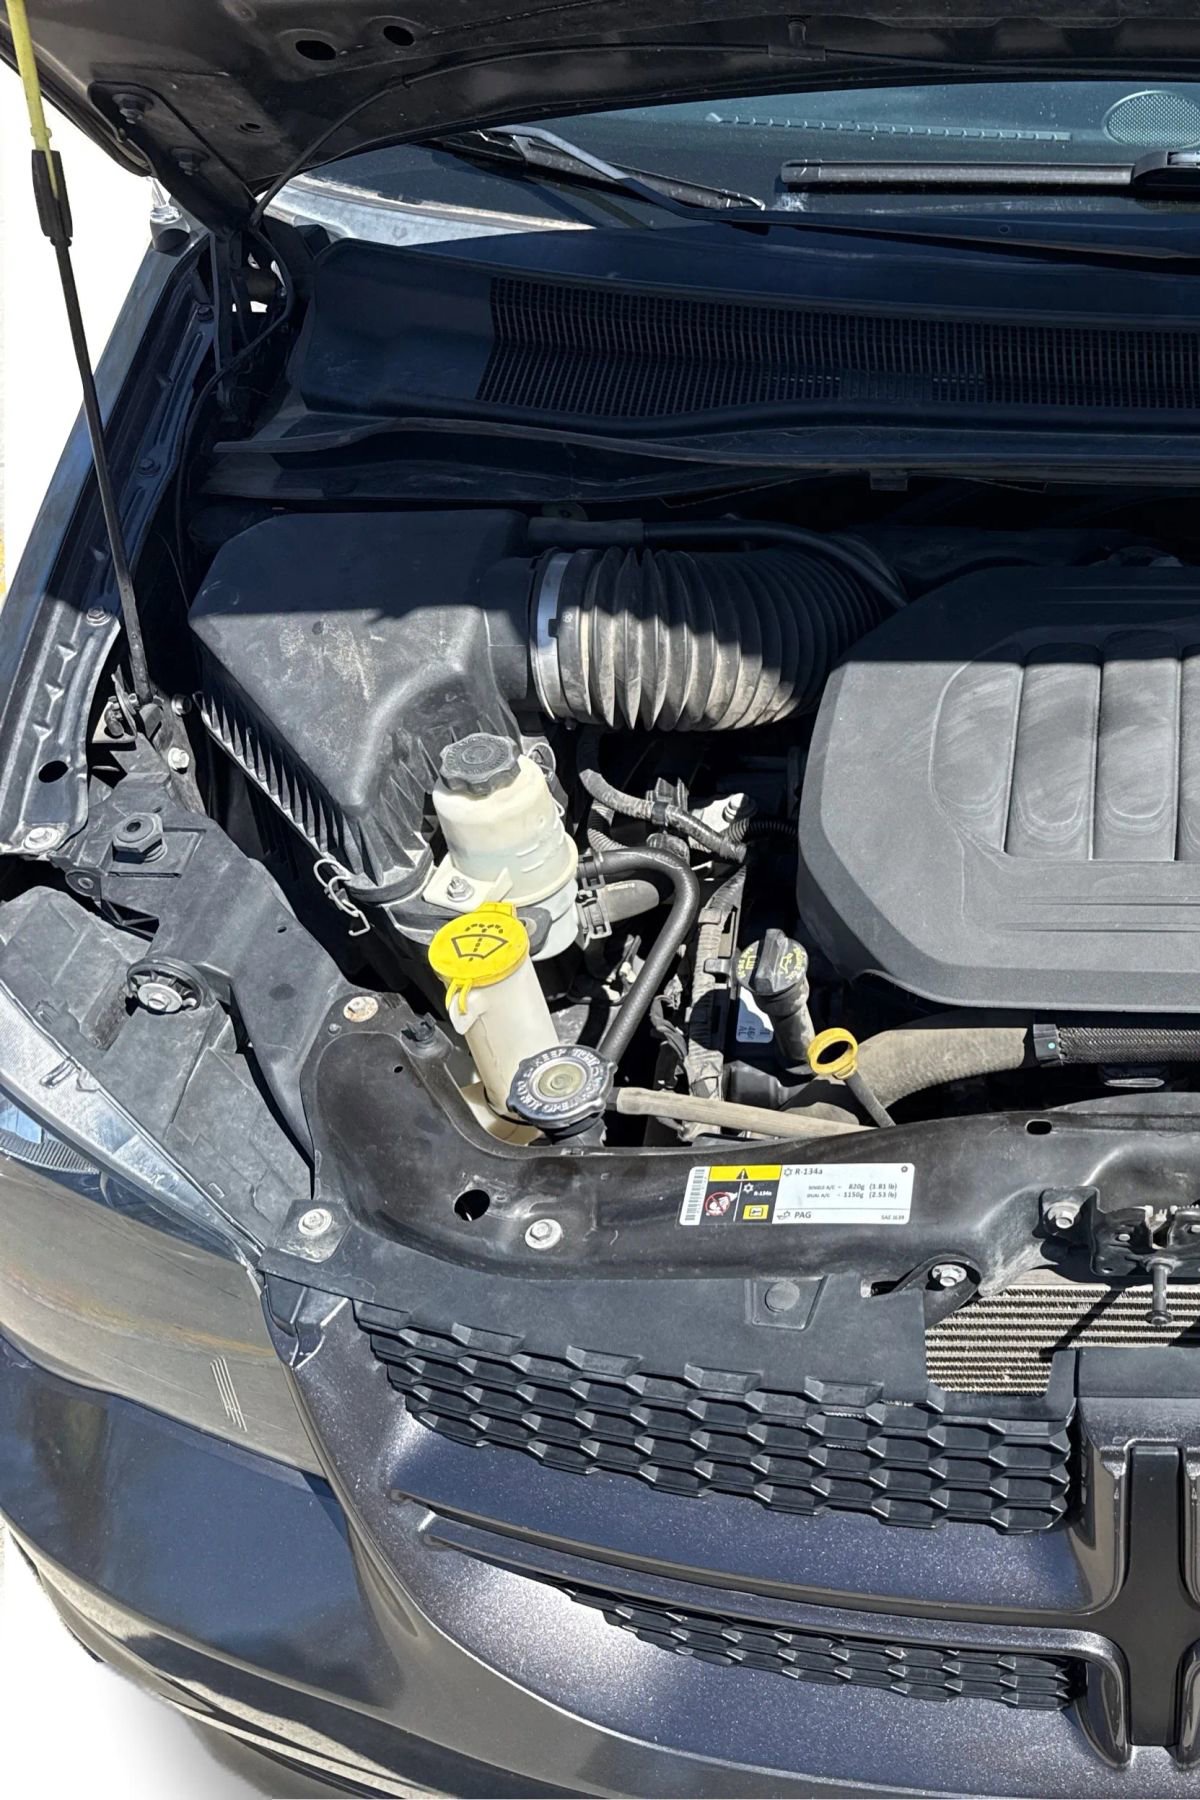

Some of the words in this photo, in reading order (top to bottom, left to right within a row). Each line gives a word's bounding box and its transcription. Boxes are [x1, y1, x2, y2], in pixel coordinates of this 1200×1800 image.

[794, 1167, 823, 1176] R-134a
[848, 1183, 865, 1191] 820g
[869, 1183, 886, 1191] (1.81
[888, 1183, 897, 1191] lb)
[843, 1191, 864, 1199] 1150g
[869, 1191, 886, 1199] (2.53
[888, 1191, 897, 1199] lb)
[794, 1211, 812, 1219] PAG
